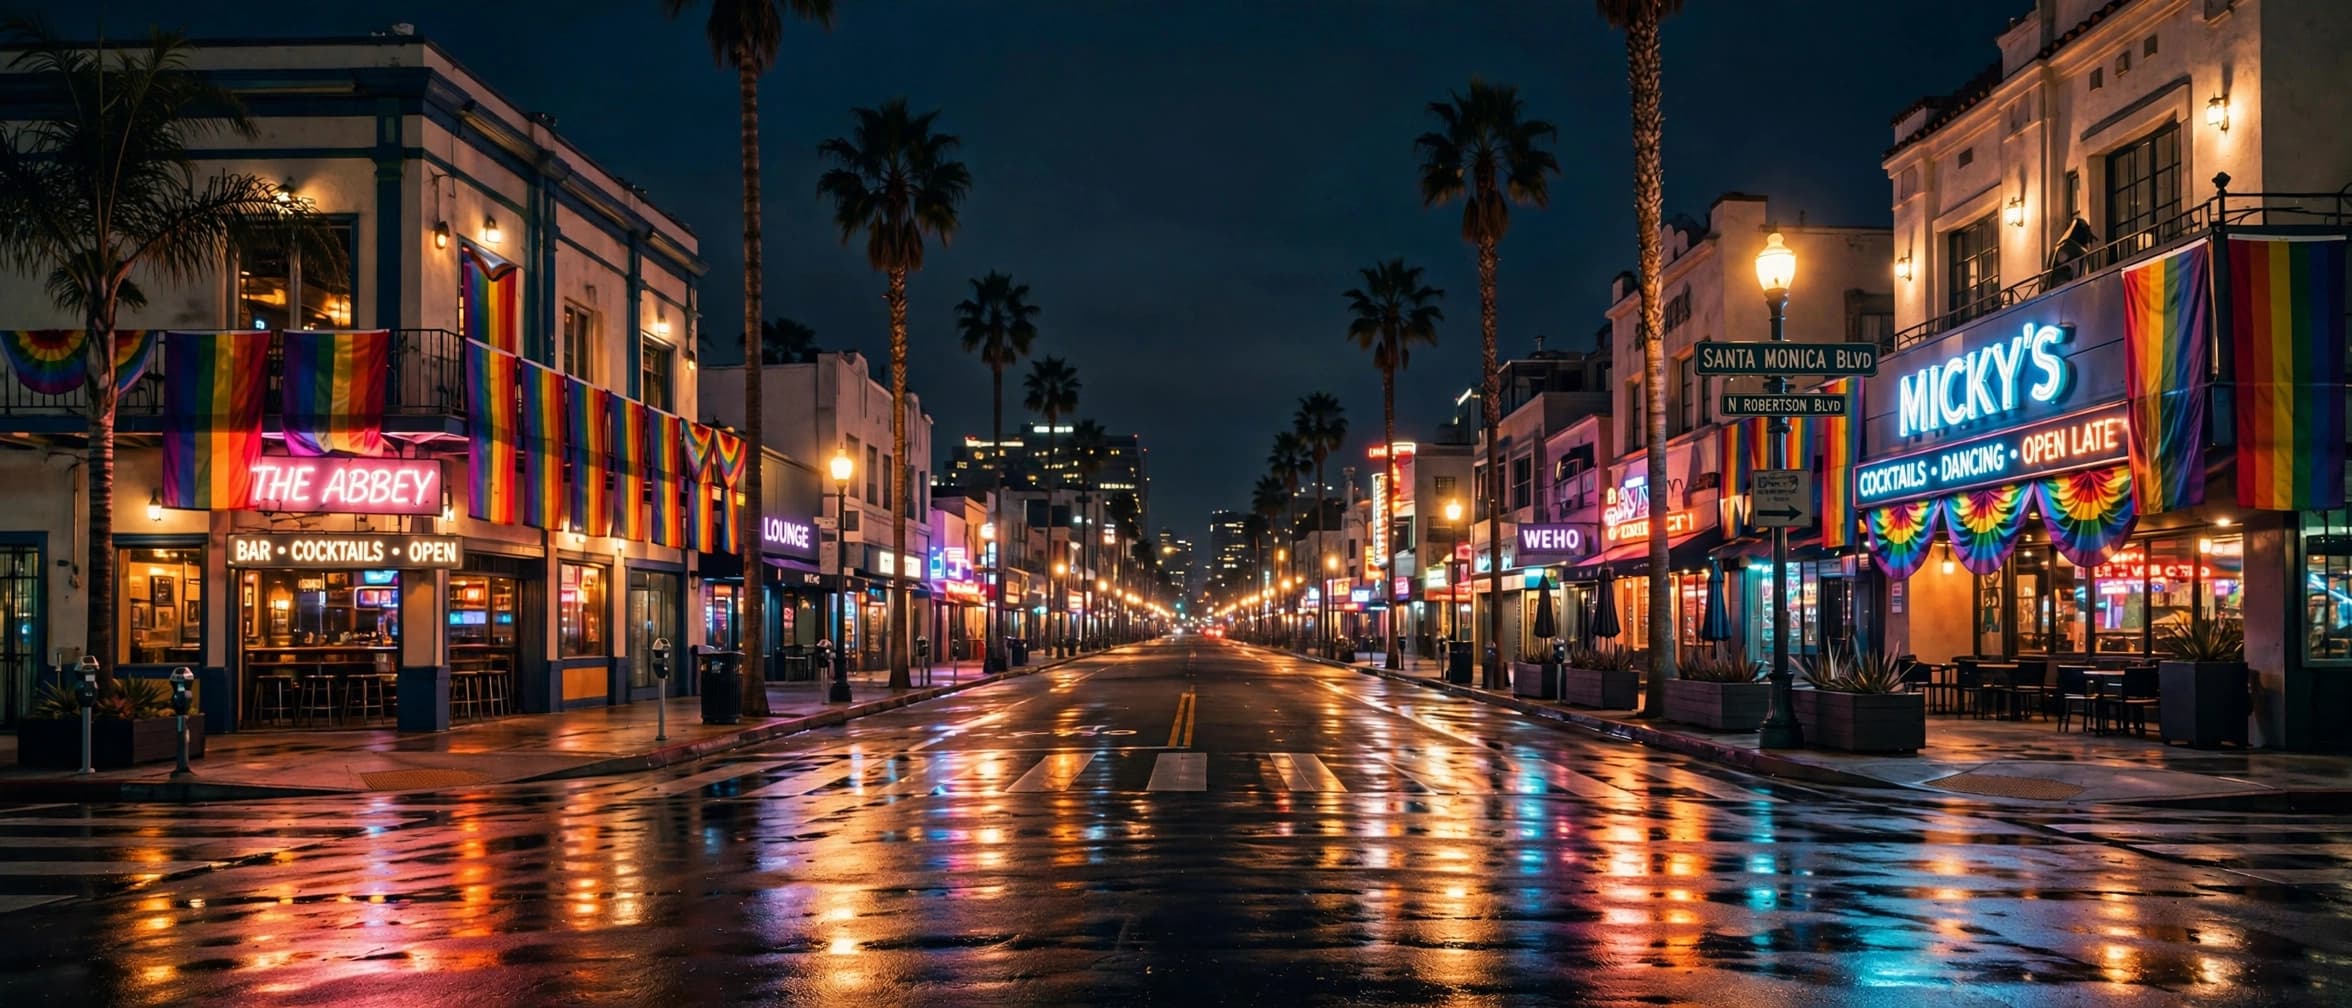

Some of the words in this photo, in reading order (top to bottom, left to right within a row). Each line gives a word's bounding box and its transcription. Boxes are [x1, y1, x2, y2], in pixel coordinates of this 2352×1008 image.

[1703, 348, 1756, 369] SANTA
[1764, 348, 1827, 369] MONICA
[1836, 350, 1872, 369] BLVD
[1899, 322, 2064, 437] MICKY'S
[1728, 398, 1737, 412] N
[1743, 398, 1807, 412] ROBERTSON
[1814, 398, 1841, 412] BLVD
[1859, 460, 1926, 497] COCKTAILS
[1941, 443, 2004, 481] DANCING
[2022, 424, 2066, 465] OPEN
[2071, 418, 2118, 455] LATE
[251, 465, 315, 501] THE
[321, 469, 435, 505] ABBEY
[764, 517, 809, 548] LOUNGE
[1523, 529, 1579, 549] WEHO
[236, 540, 271, 561] BAR
[291, 540, 383, 561] COCKTAILS
[409, 542, 456, 562] OPEN
